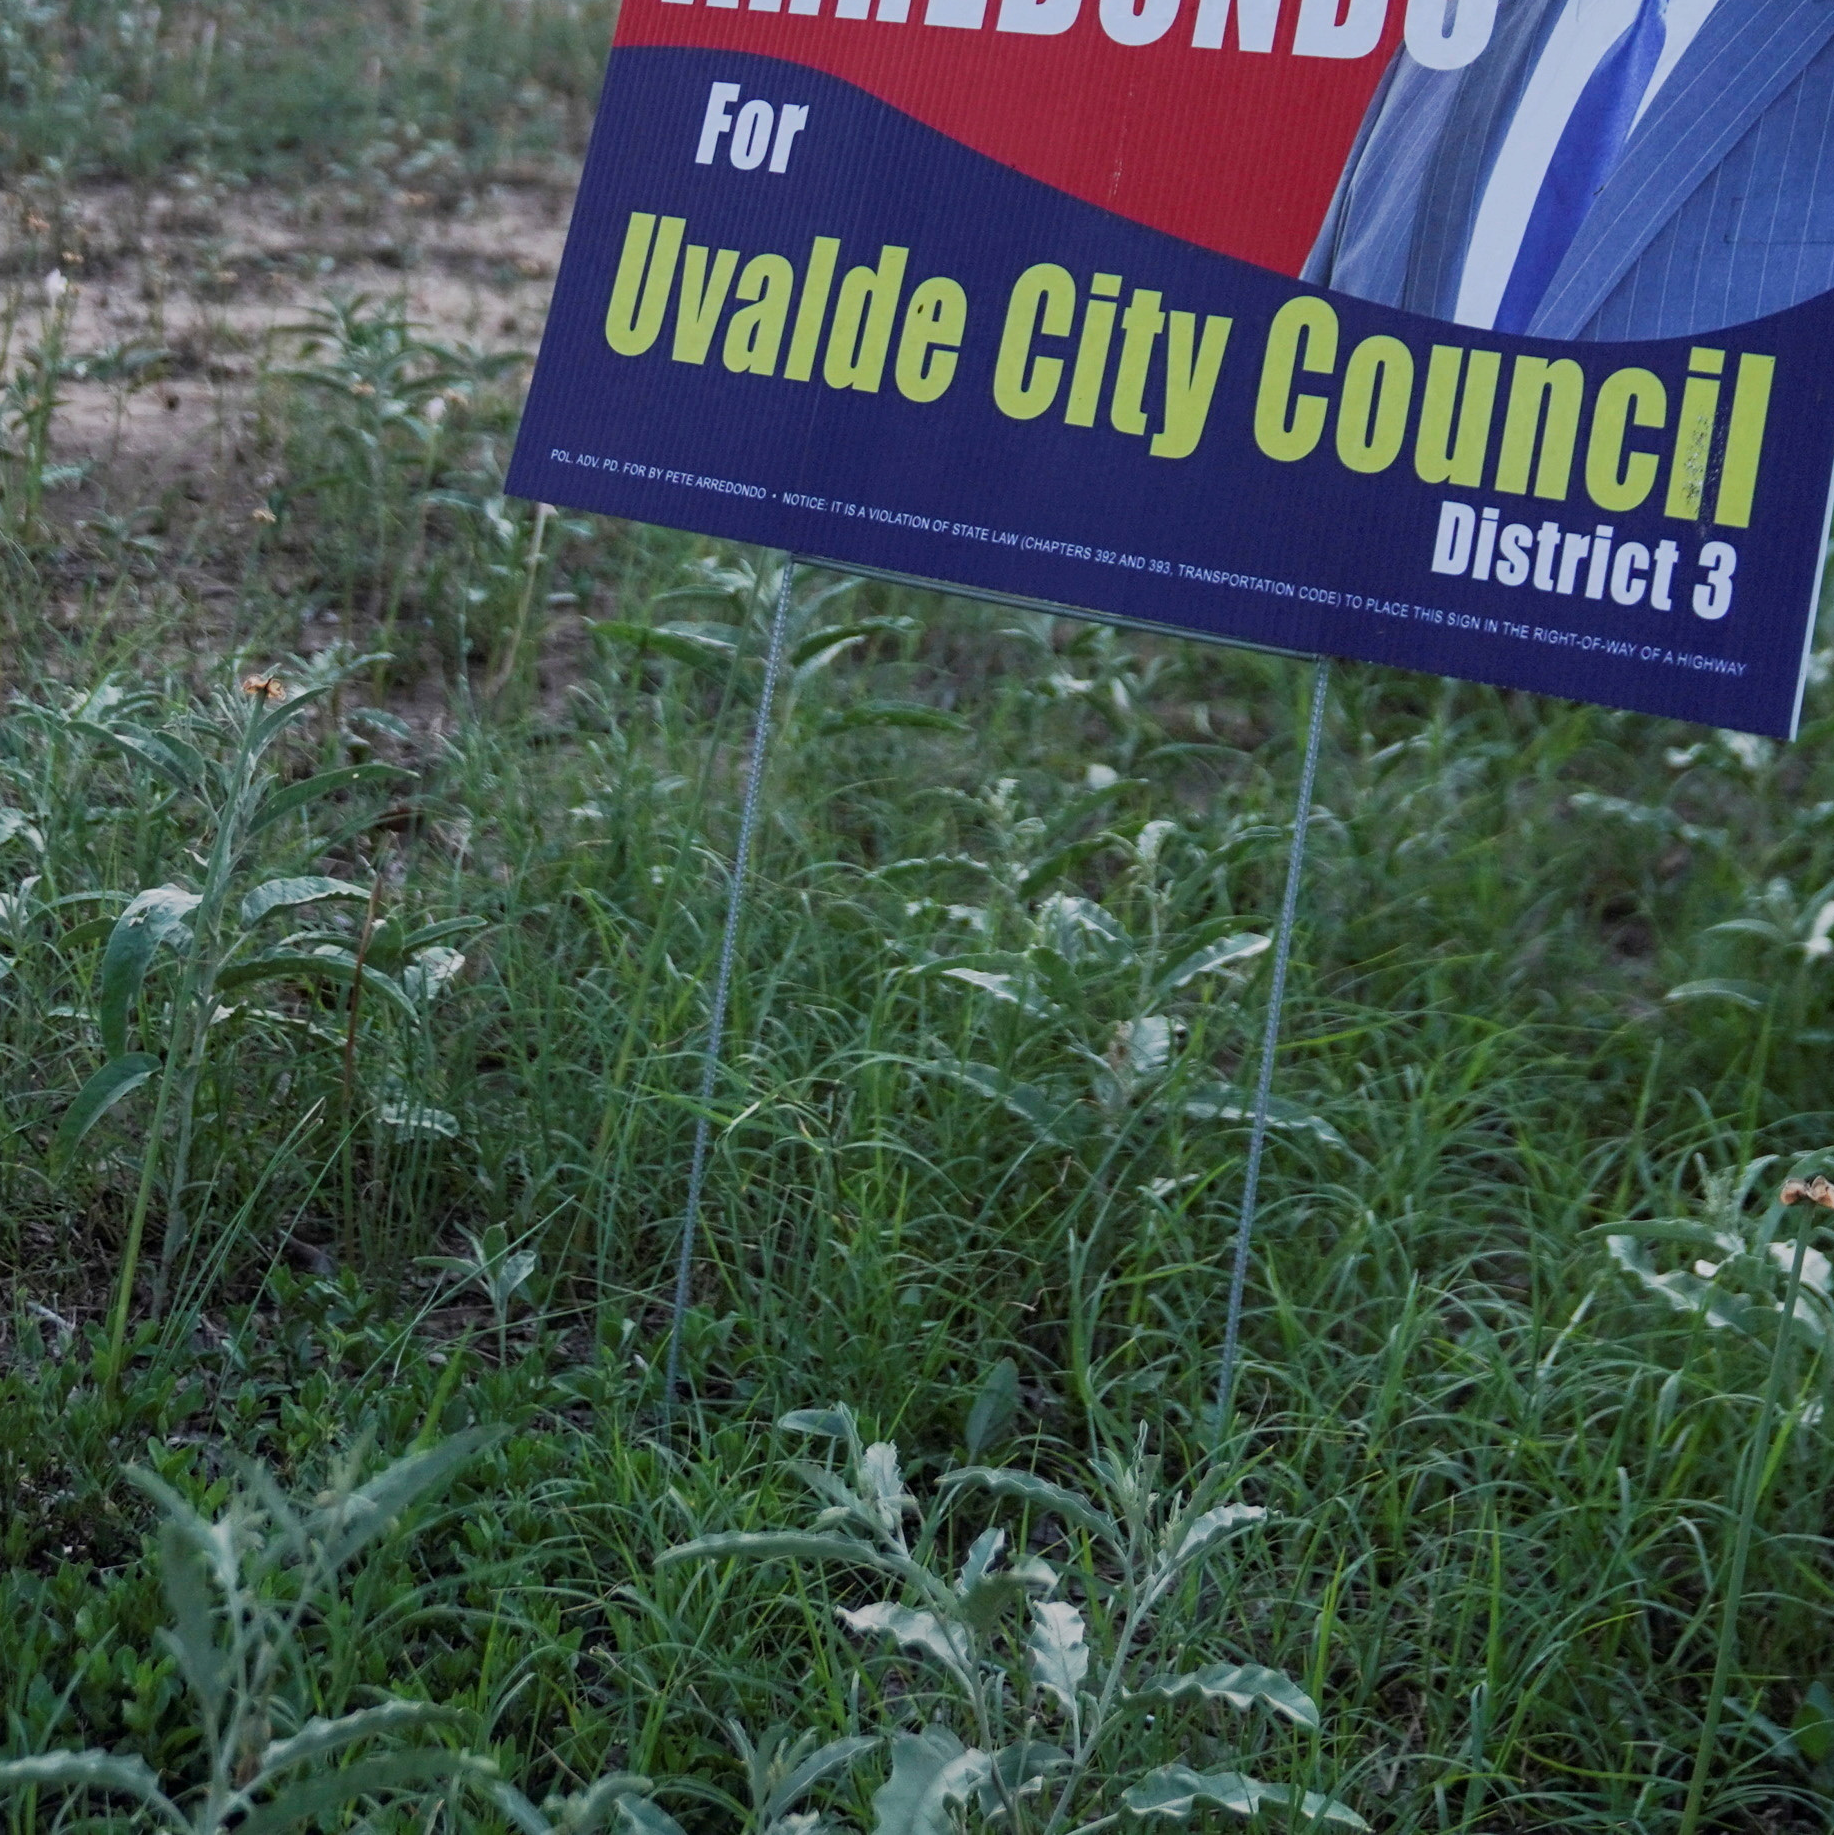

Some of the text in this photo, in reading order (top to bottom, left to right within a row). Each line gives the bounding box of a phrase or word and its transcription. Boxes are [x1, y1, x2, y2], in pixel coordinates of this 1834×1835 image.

[695, 81, 809, 174] For
[604, 212, 1777, 528] Uvalde City Council
[550, 448, 1746, 674] POL. ADV. PD. FOR BY PETE ARREDONDO NOTICE: IT IS A VIOLATION OF STATE LAW (CHAPTERS 392 AND 393, TRANSPORTATION CODE) TO PLACE THIS SIGN IN THE RIGHT-OF-WAY OF A HIGHWAY
[1433, 501, 1738, 620] District 3
